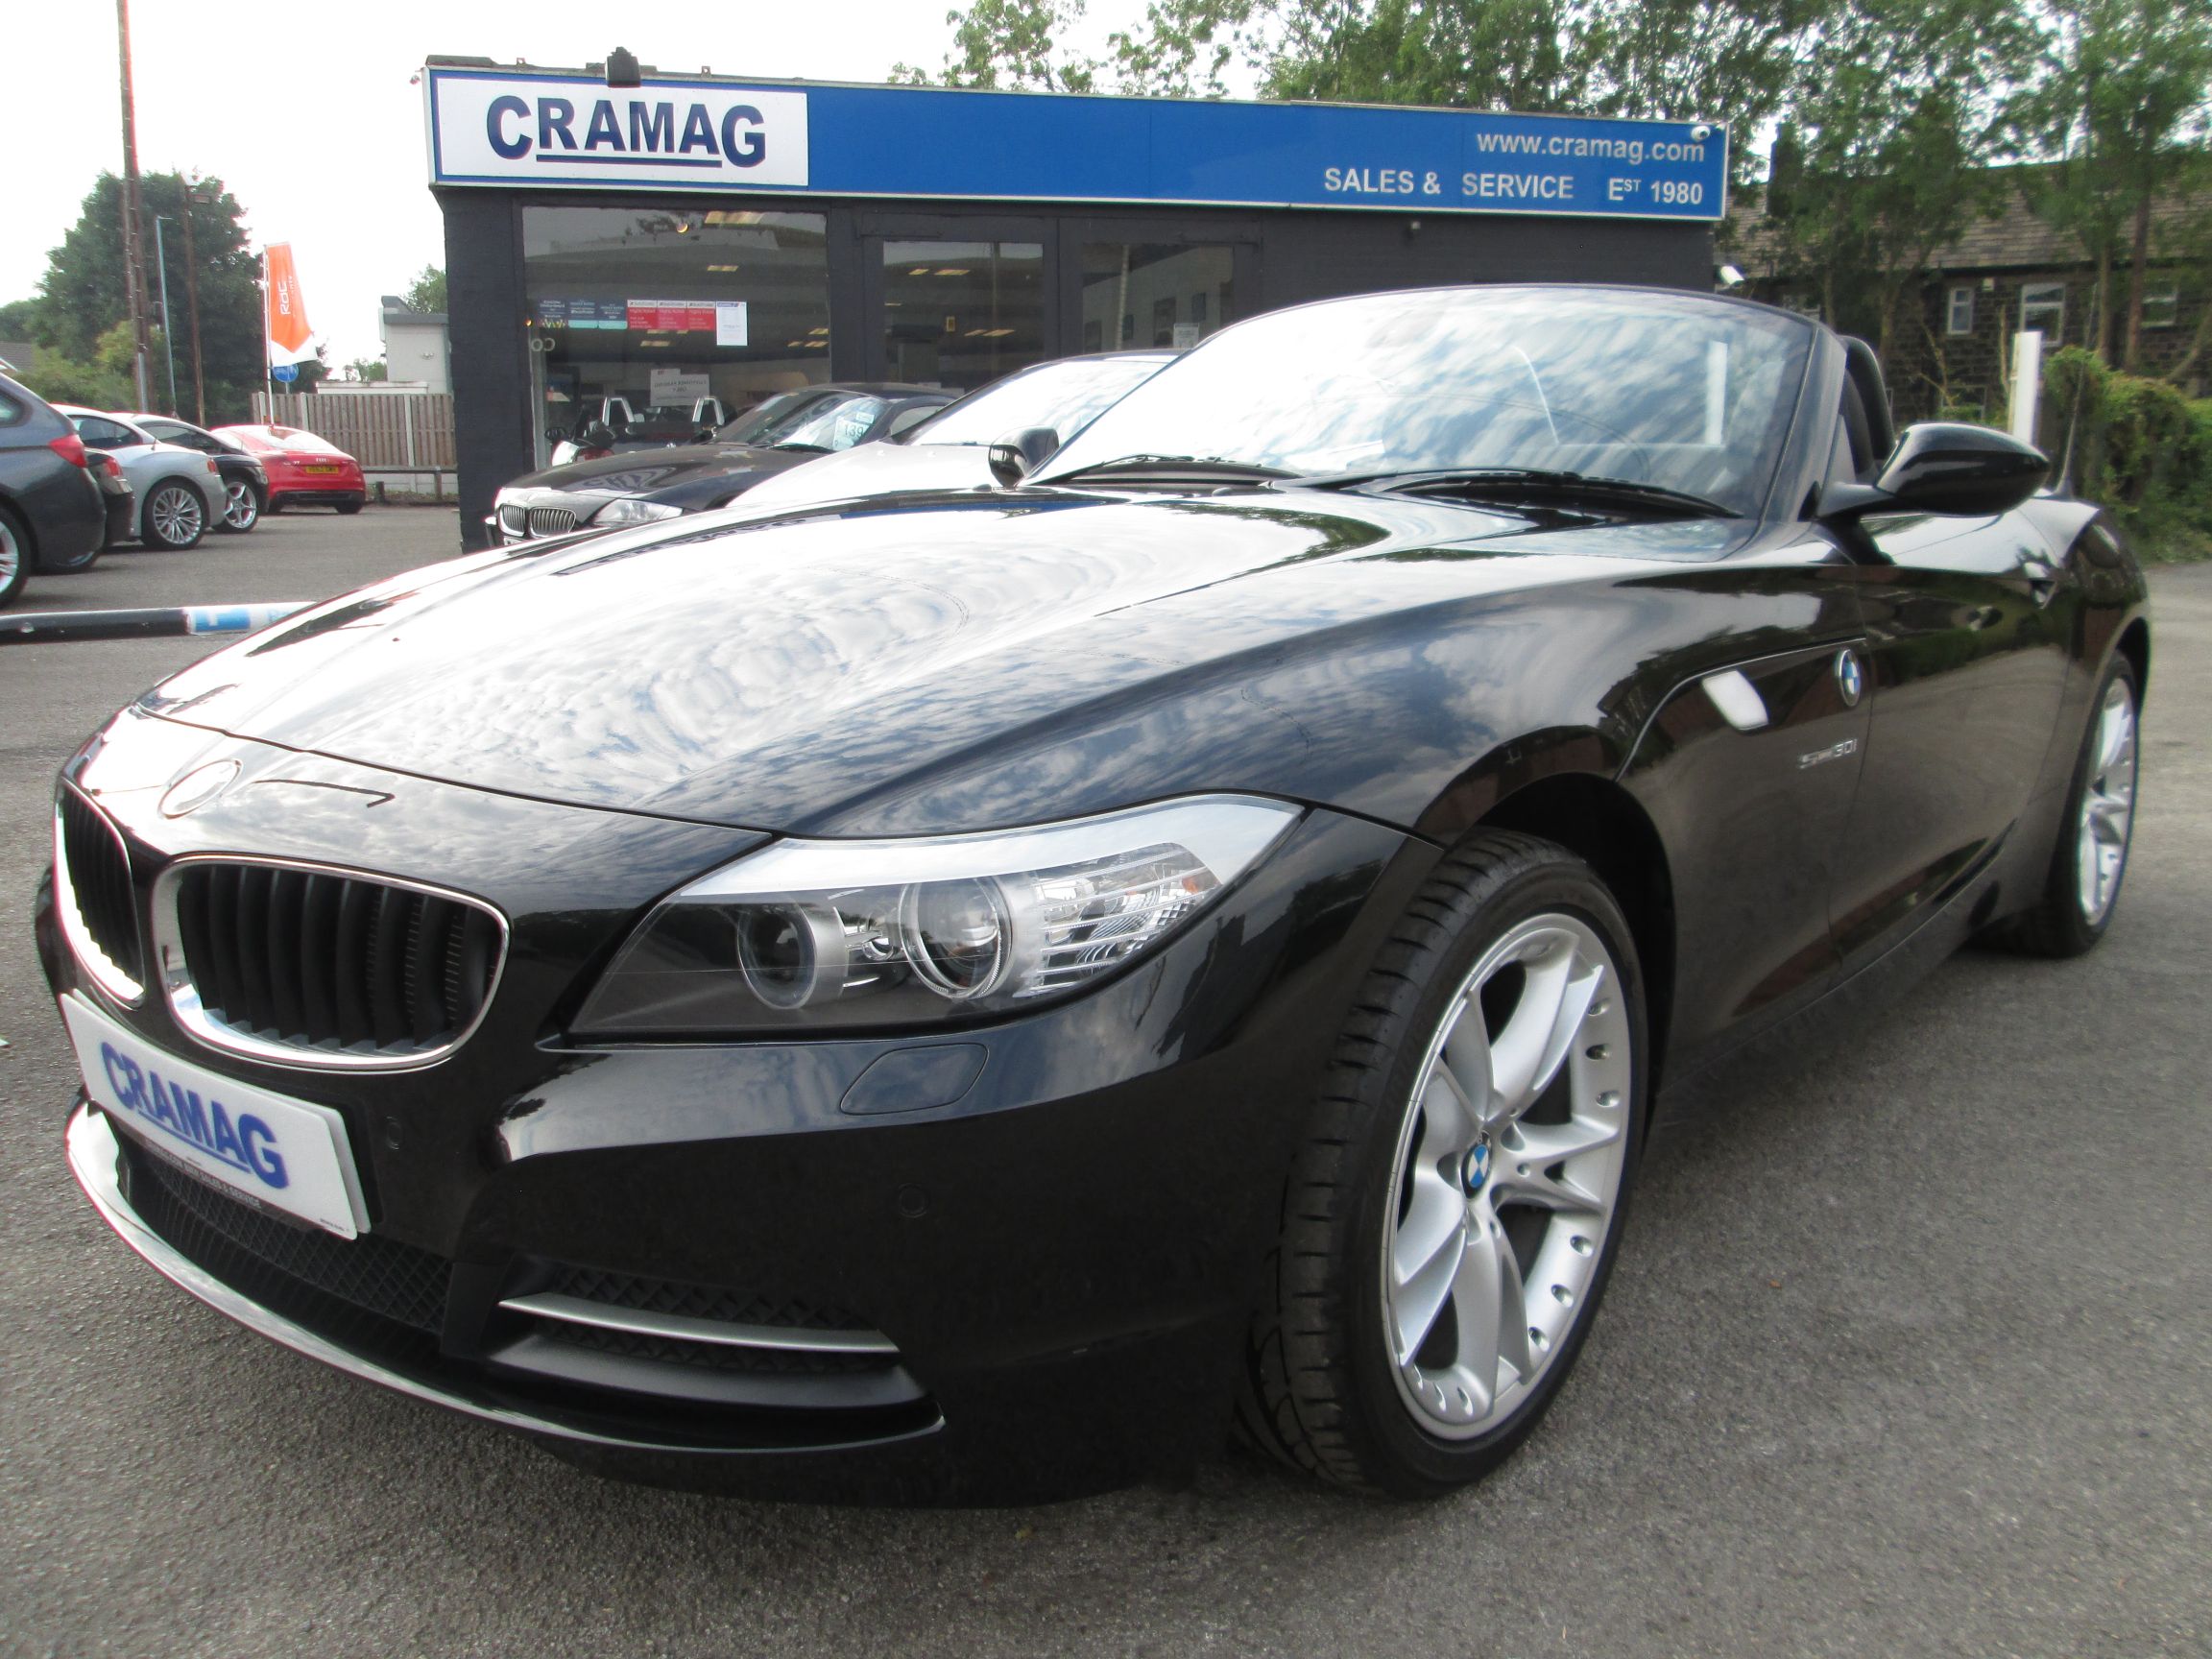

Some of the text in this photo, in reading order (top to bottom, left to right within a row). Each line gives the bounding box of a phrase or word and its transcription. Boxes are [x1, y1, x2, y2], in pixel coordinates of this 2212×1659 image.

[487, 95, 766, 167] CRAMAG
[1477, 133, 1705, 165] www.cramag.com
[1324, 167, 1414, 194] SALES
[1423, 172, 1440, 195] &
[1461, 173, 1574, 199] SERVICE
[1650, 180, 1703, 204] 1980
[101, 1042, 289, 1190] CRAMAG
